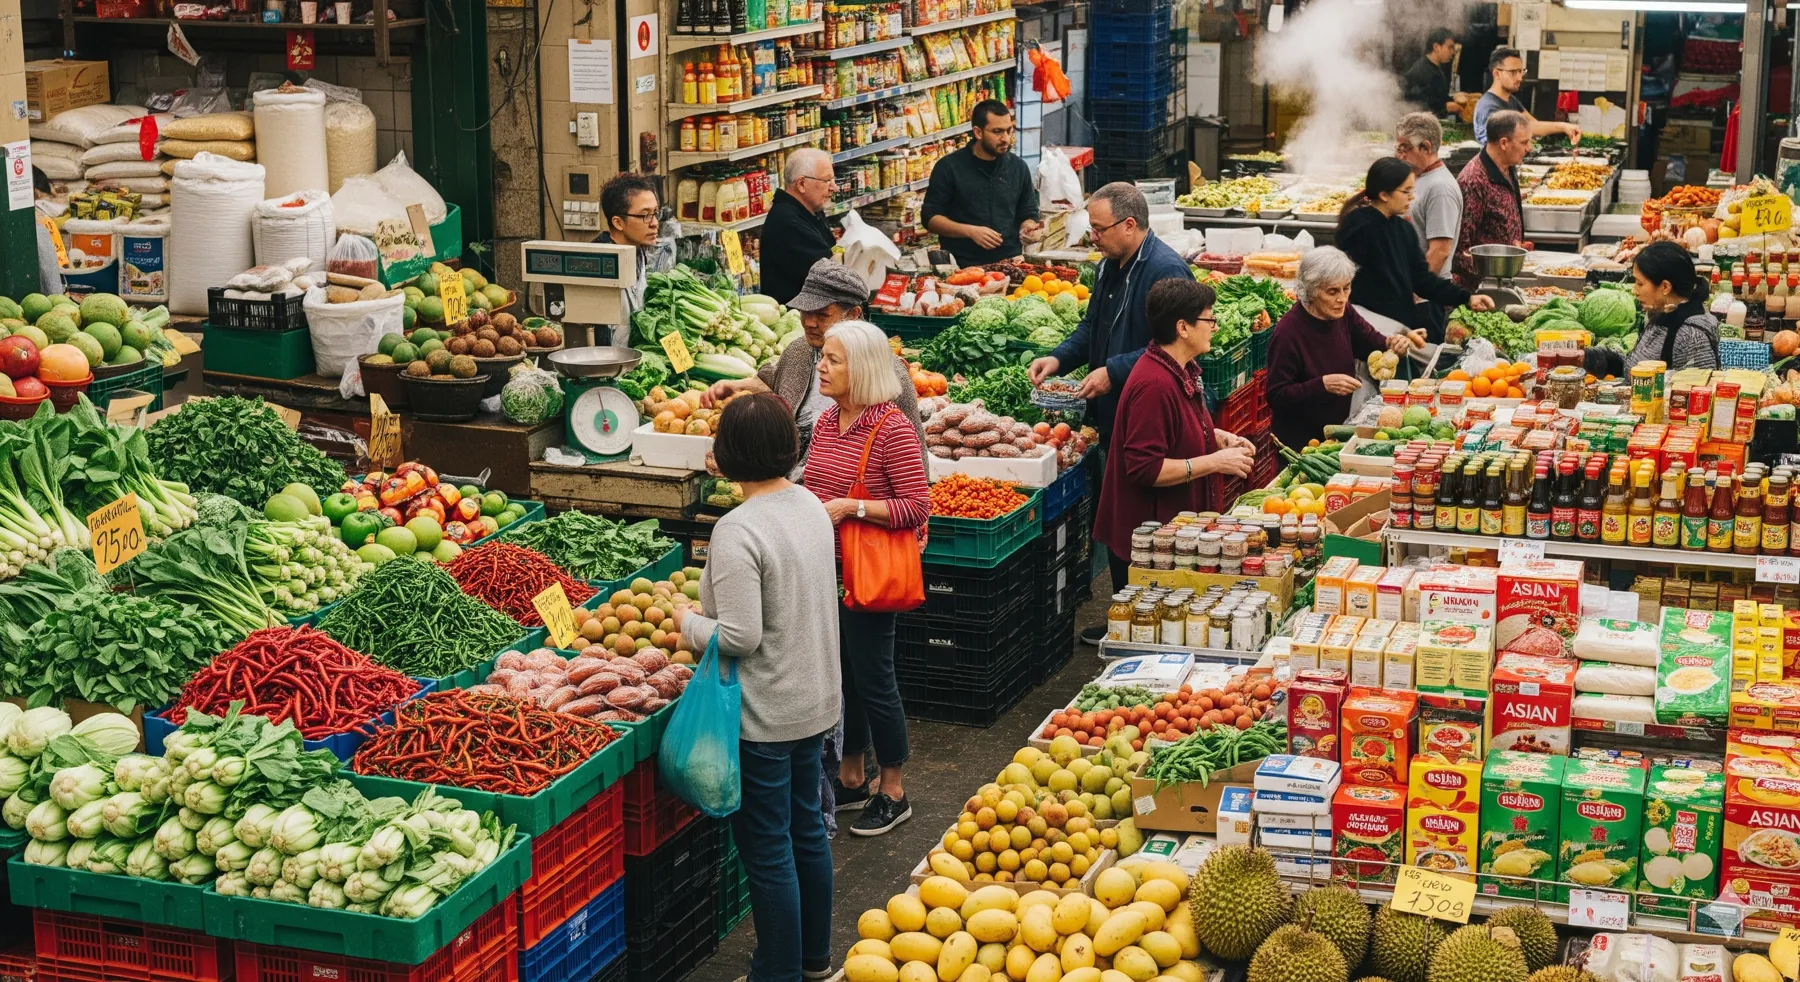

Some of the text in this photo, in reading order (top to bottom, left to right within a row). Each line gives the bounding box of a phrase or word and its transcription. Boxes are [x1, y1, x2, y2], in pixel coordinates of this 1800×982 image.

[1511, 582, 1560, 598] ASIAN
[1501, 702, 1557, 723] ASIAN
[1748, 811, 1800, 829] ASIAN
